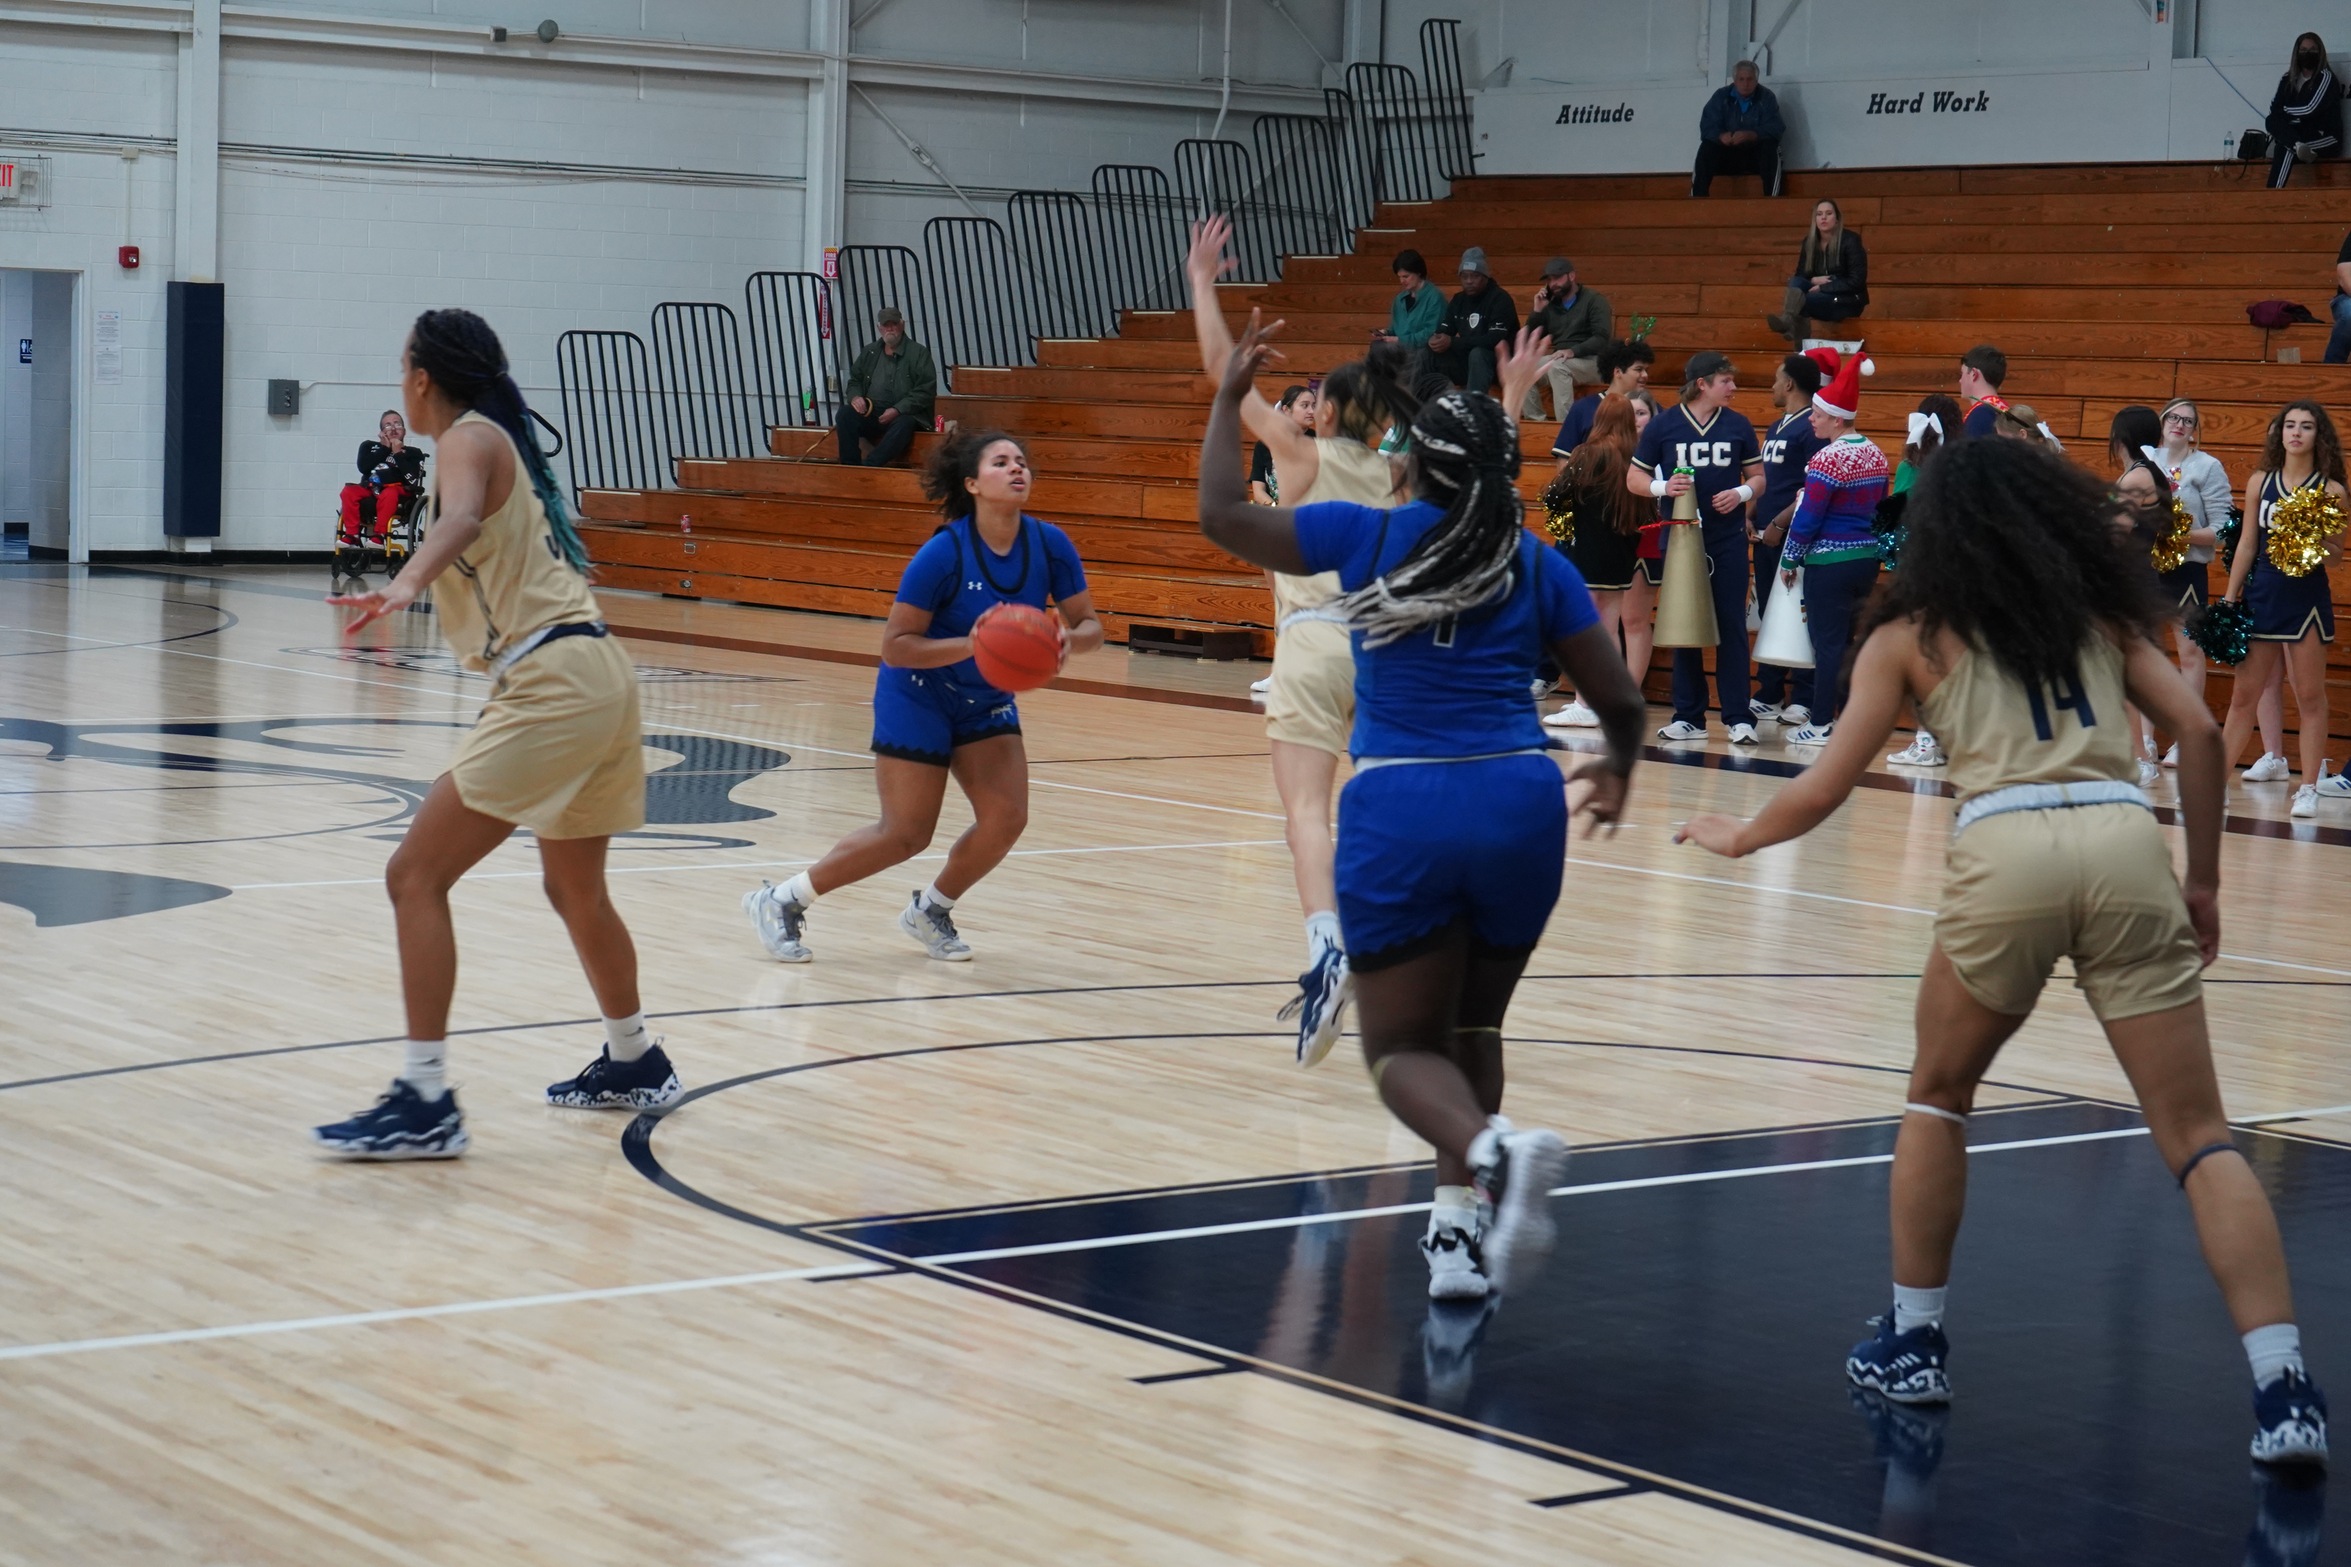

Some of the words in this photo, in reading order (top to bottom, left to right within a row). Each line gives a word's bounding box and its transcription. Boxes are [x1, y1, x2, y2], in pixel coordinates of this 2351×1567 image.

[1555, 102, 1634, 125] Attitude
[1866, 91, 1925, 115] Hard
[1933, 90, 1990, 113] Work
[0, 164, 14, 187] IT
[1675, 441, 1732, 467] ICC
